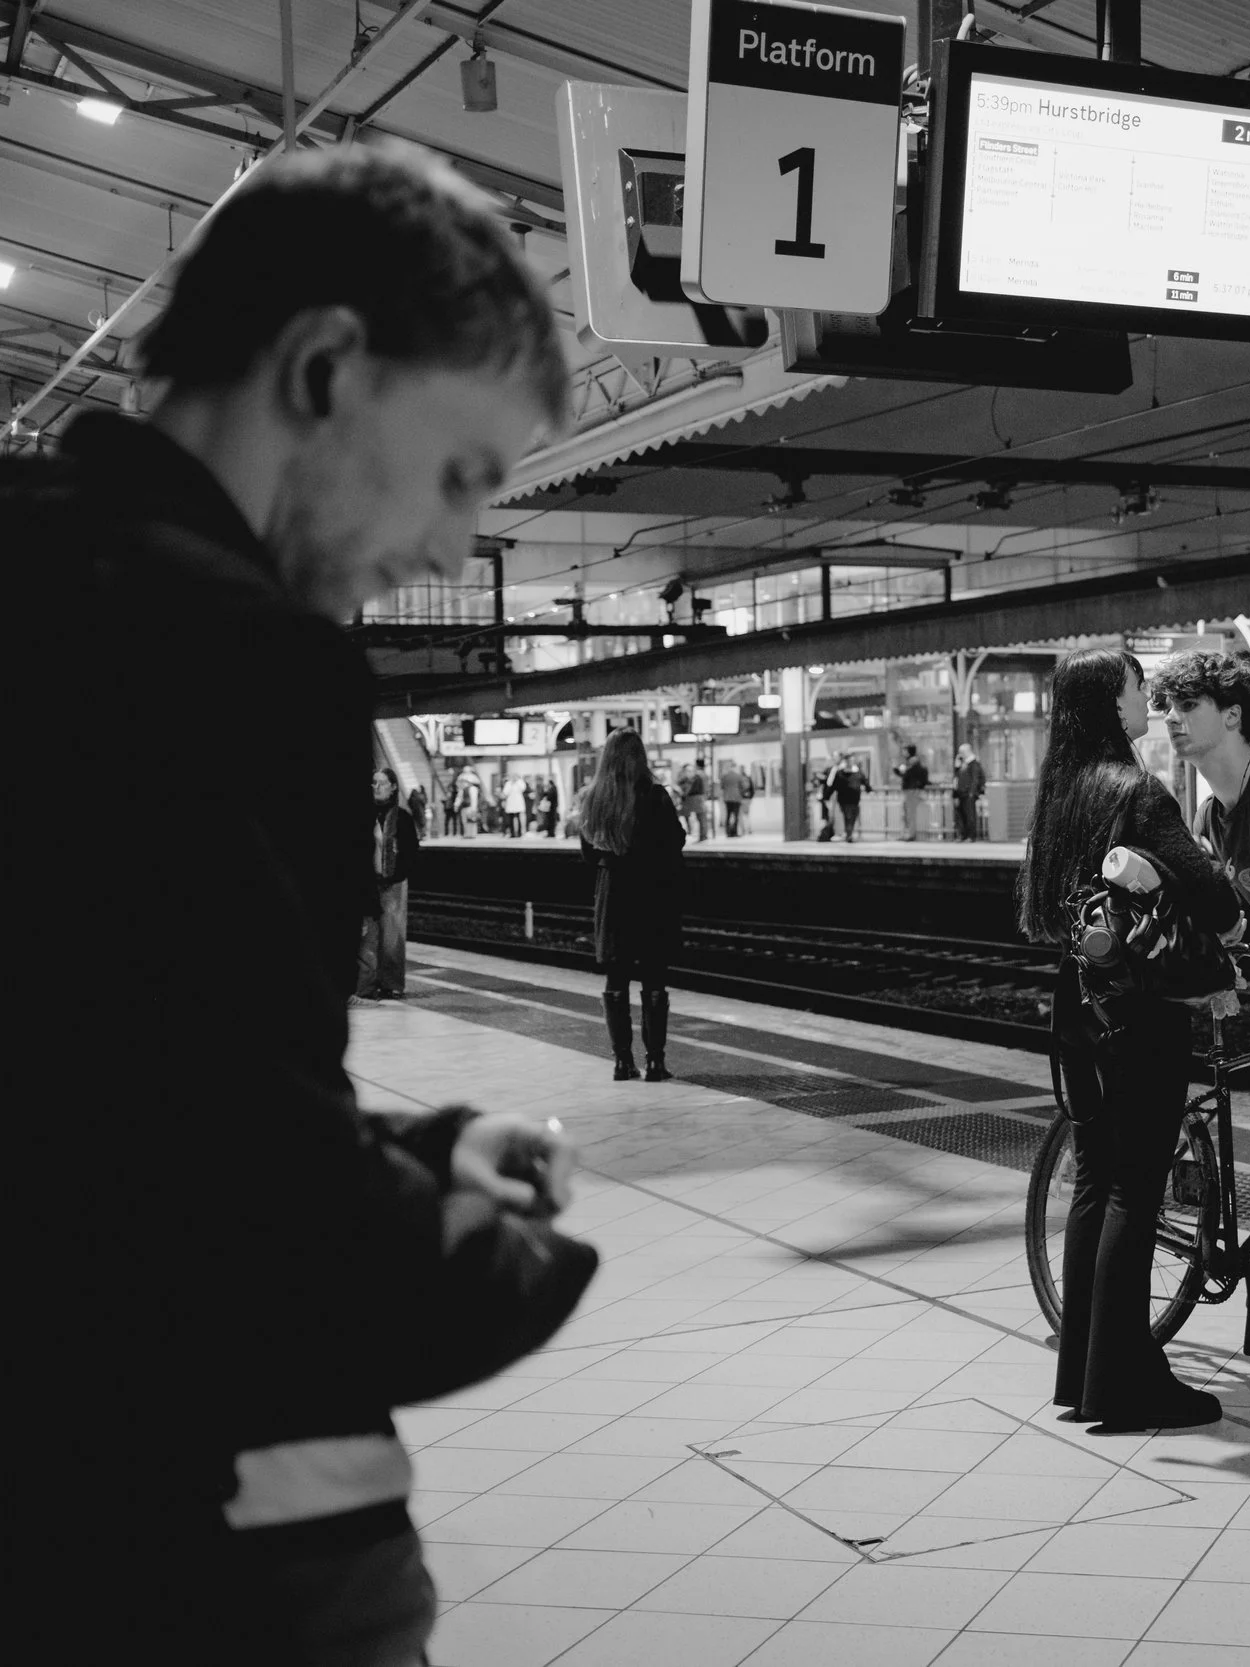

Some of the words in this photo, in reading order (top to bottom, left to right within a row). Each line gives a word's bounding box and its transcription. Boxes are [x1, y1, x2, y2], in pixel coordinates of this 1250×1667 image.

[737, 29, 876, 77] Platform
[976, 93, 1032, 115] 5:39pm
[1038, 99, 1142, 131] Hurstbridge
[1235, 126, 1244, 141] 2
[980, 139, 1011, 151] Flinders
[1012, 143, 1037, 154] Street
[774, 146, 826, 259] 1
[1173, 272, 1179, 280] 6
[1180, 272, 1193, 282] min
[1171, 291, 1178, 299] 11
[1179, 291, 1192, 300] min
